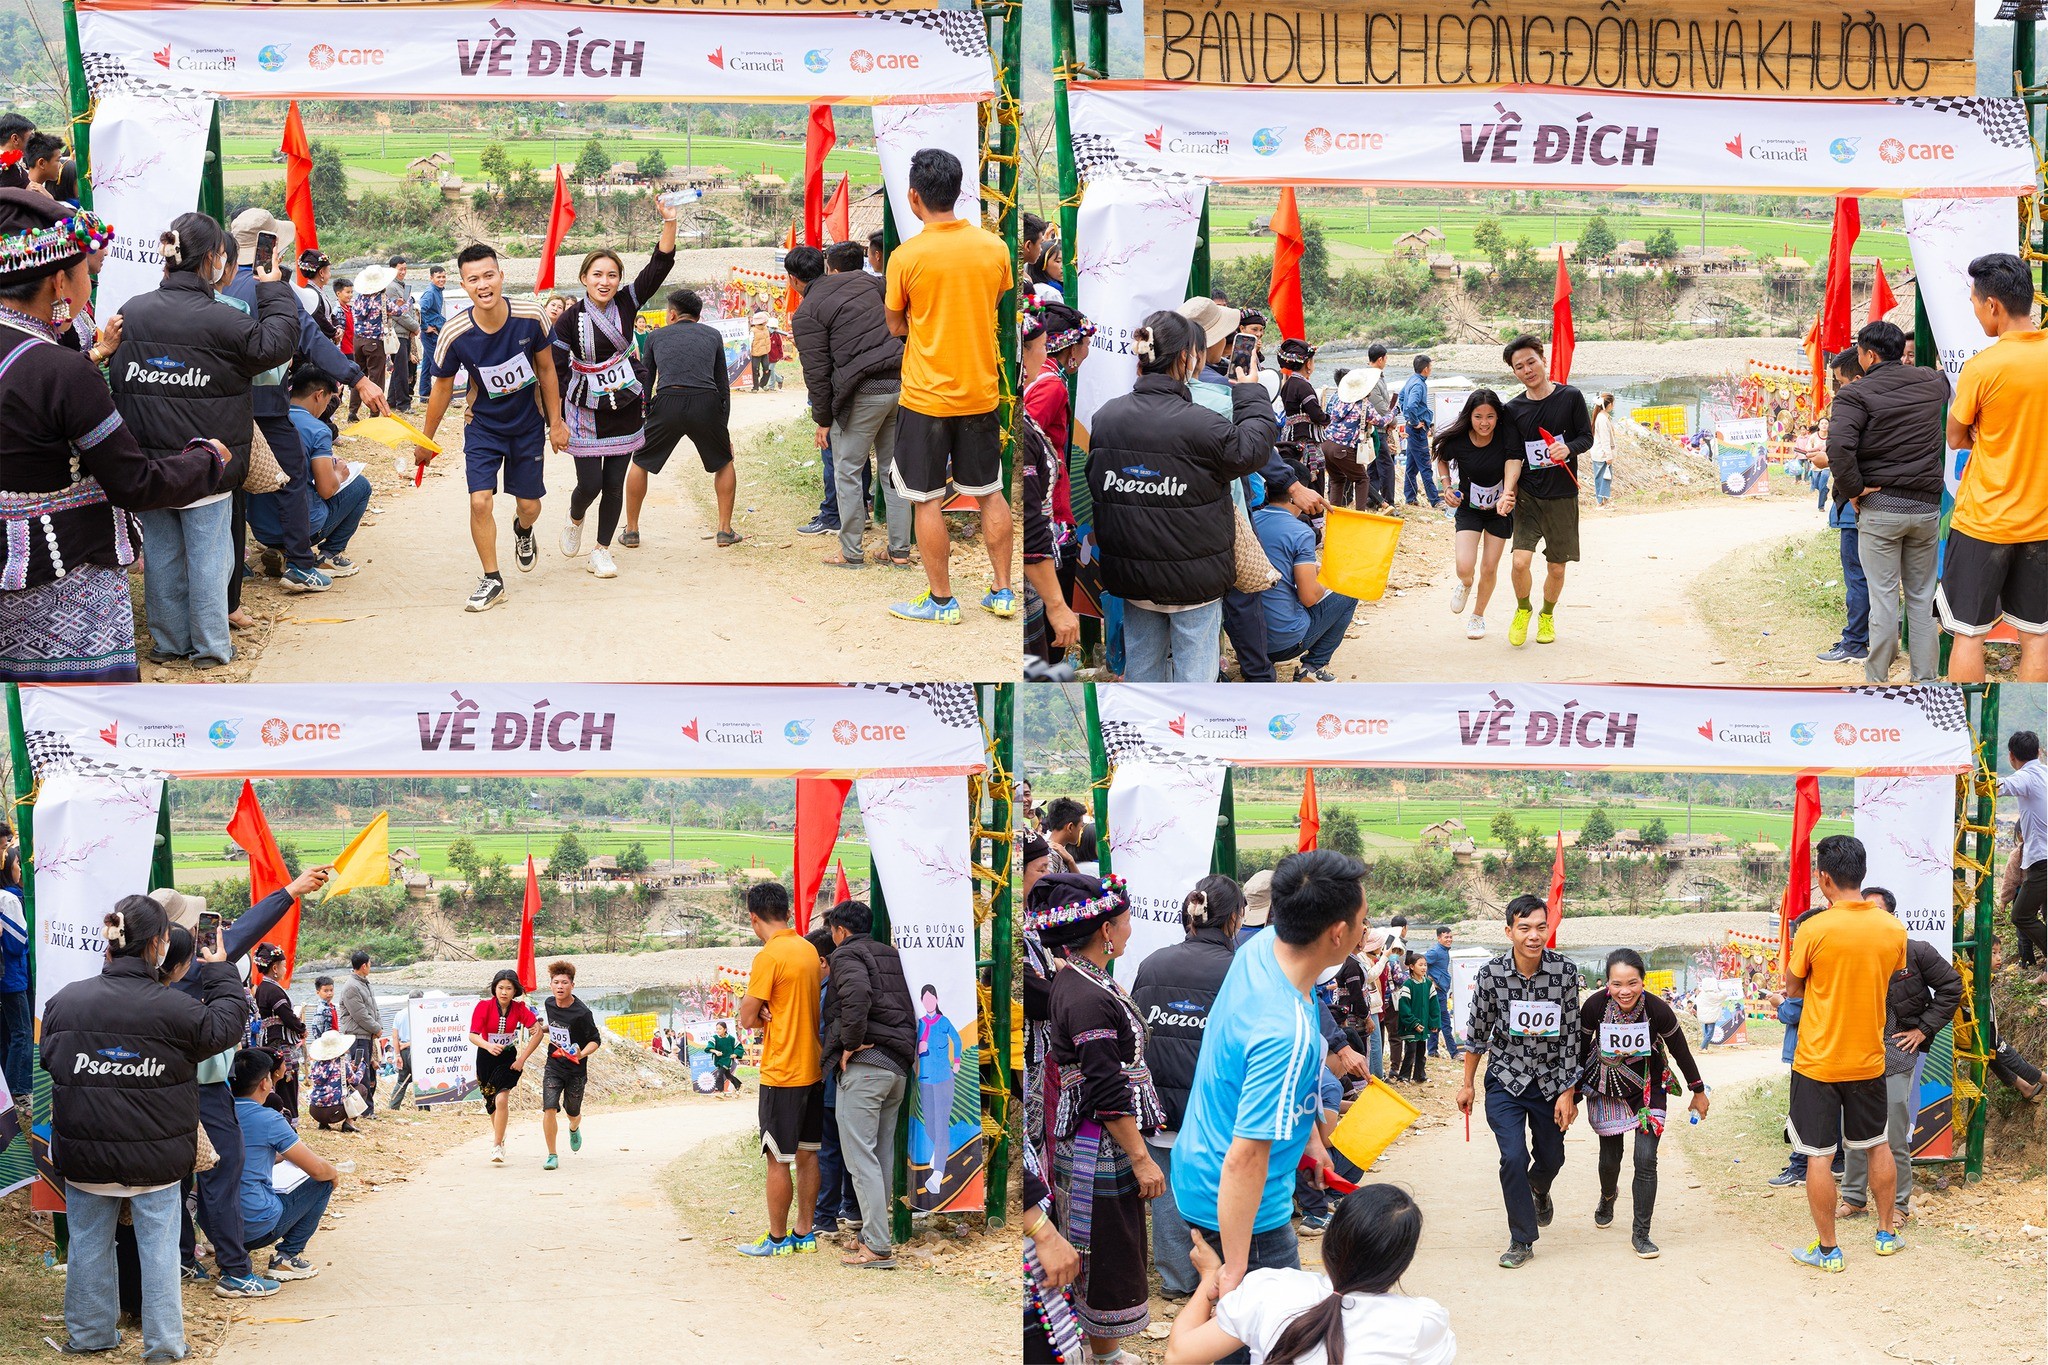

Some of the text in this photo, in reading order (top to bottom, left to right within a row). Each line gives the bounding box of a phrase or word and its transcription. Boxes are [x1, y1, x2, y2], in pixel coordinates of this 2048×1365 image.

[457, 18, 645, 78] VỀ ĐÍCH
[1689, 7, 1747, 90] NÀ
[177, 56, 236, 71] Canada
[338, 48, 384, 66] care
[730, 58, 784, 72] Canada
[876, 54, 919, 69] care
[1334, 132, 1383, 150] care
[1460, 101, 1659, 166] VỀ ĐÍCH
[1169, 139, 1229, 154] Canada
[1749, 146, 1808, 162] Canada
[1908, 143, 1954, 160] care
[110, 246, 133, 261] MÙA
[1092, 334, 1113, 352] MÙA
[1942, 350, 1965, 358] UNG
[125, 361, 211, 387] Psezodir
[490, 366, 525, 388] Q01
[596, 366, 626, 386] R01
[1534, 448, 1551, 461] S0
[1103, 470, 1188, 496] Psezodir
[1477, 489, 1500, 505] Y02
[417, 690, 616, 752] VỀ ĐÍCH
[1344, 718, 1389, 736] care
[1458, 690, 1638, 748] VỀ ĐÍCH
[292, 721, 341, 741] care
[705, 729, 763, 744] Canada
[860, 724, 906, 741] care
[1191, 724, 1248, 740] Canada
[1719, 730, 1772, 744] Canada
[1860, 727, 1900, 742] care
[124, 733, 186, 748] Canada
[1154, 898, 1184, 910] ĐƯỜ
[1130, 904, 1184, 924] MÙA XUÂ
[1906, 908, 1946, 918] ĐƯỜNG
[52, 920, 74, 932] CUNG
[894, 922, 965, 934] UNG ĐƯỜNG
[1906, 918, 1946, 930] XUÂN
[50, 932, 74, 950] MÙA
[926, 933, 965, 948] XUÂN
[432, 1014, 450, 1022] ĐÍCH
[1148, 1005, 1208, 1029] Psezo
[1518, 1012, 1555, 1029] Q06
[552, 1032, 568, 1042] S05
[1610, 1034, 1645, 1048] R06
[427, 1046, 441, 1054] CON
[74, 1052, 166, 1077] Psezodir
[444, 1056, 462, 1064] CHẠY
